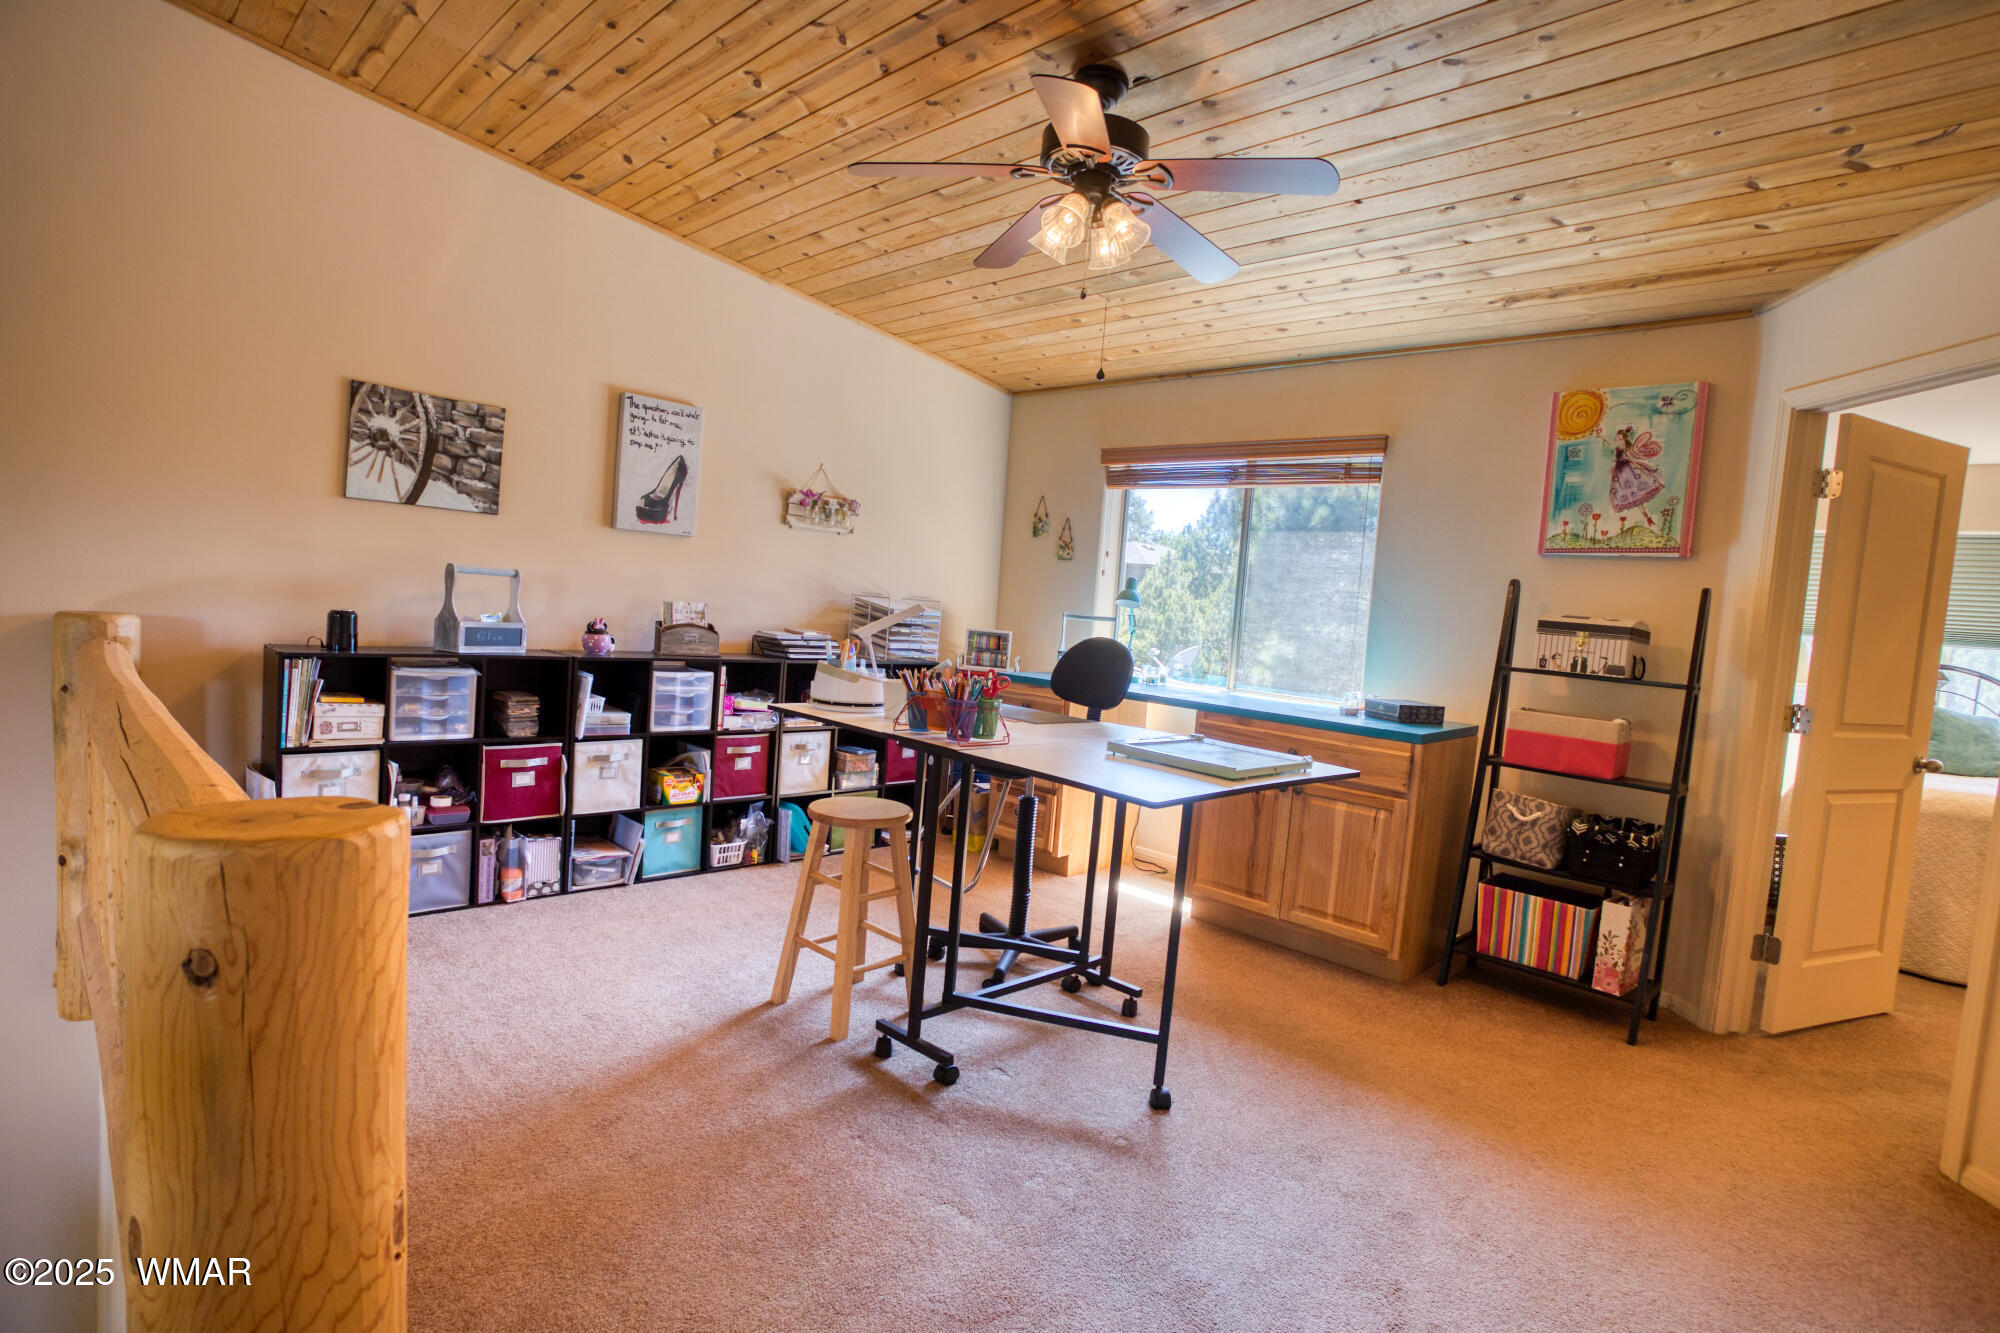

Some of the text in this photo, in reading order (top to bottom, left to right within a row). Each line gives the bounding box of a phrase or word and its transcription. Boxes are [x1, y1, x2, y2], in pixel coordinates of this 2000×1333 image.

[626, 395, 640, 409] The
[629, 412, 649, 425] going
[658, 414, 669, 424] let
[667, 436, 687, 448] going
